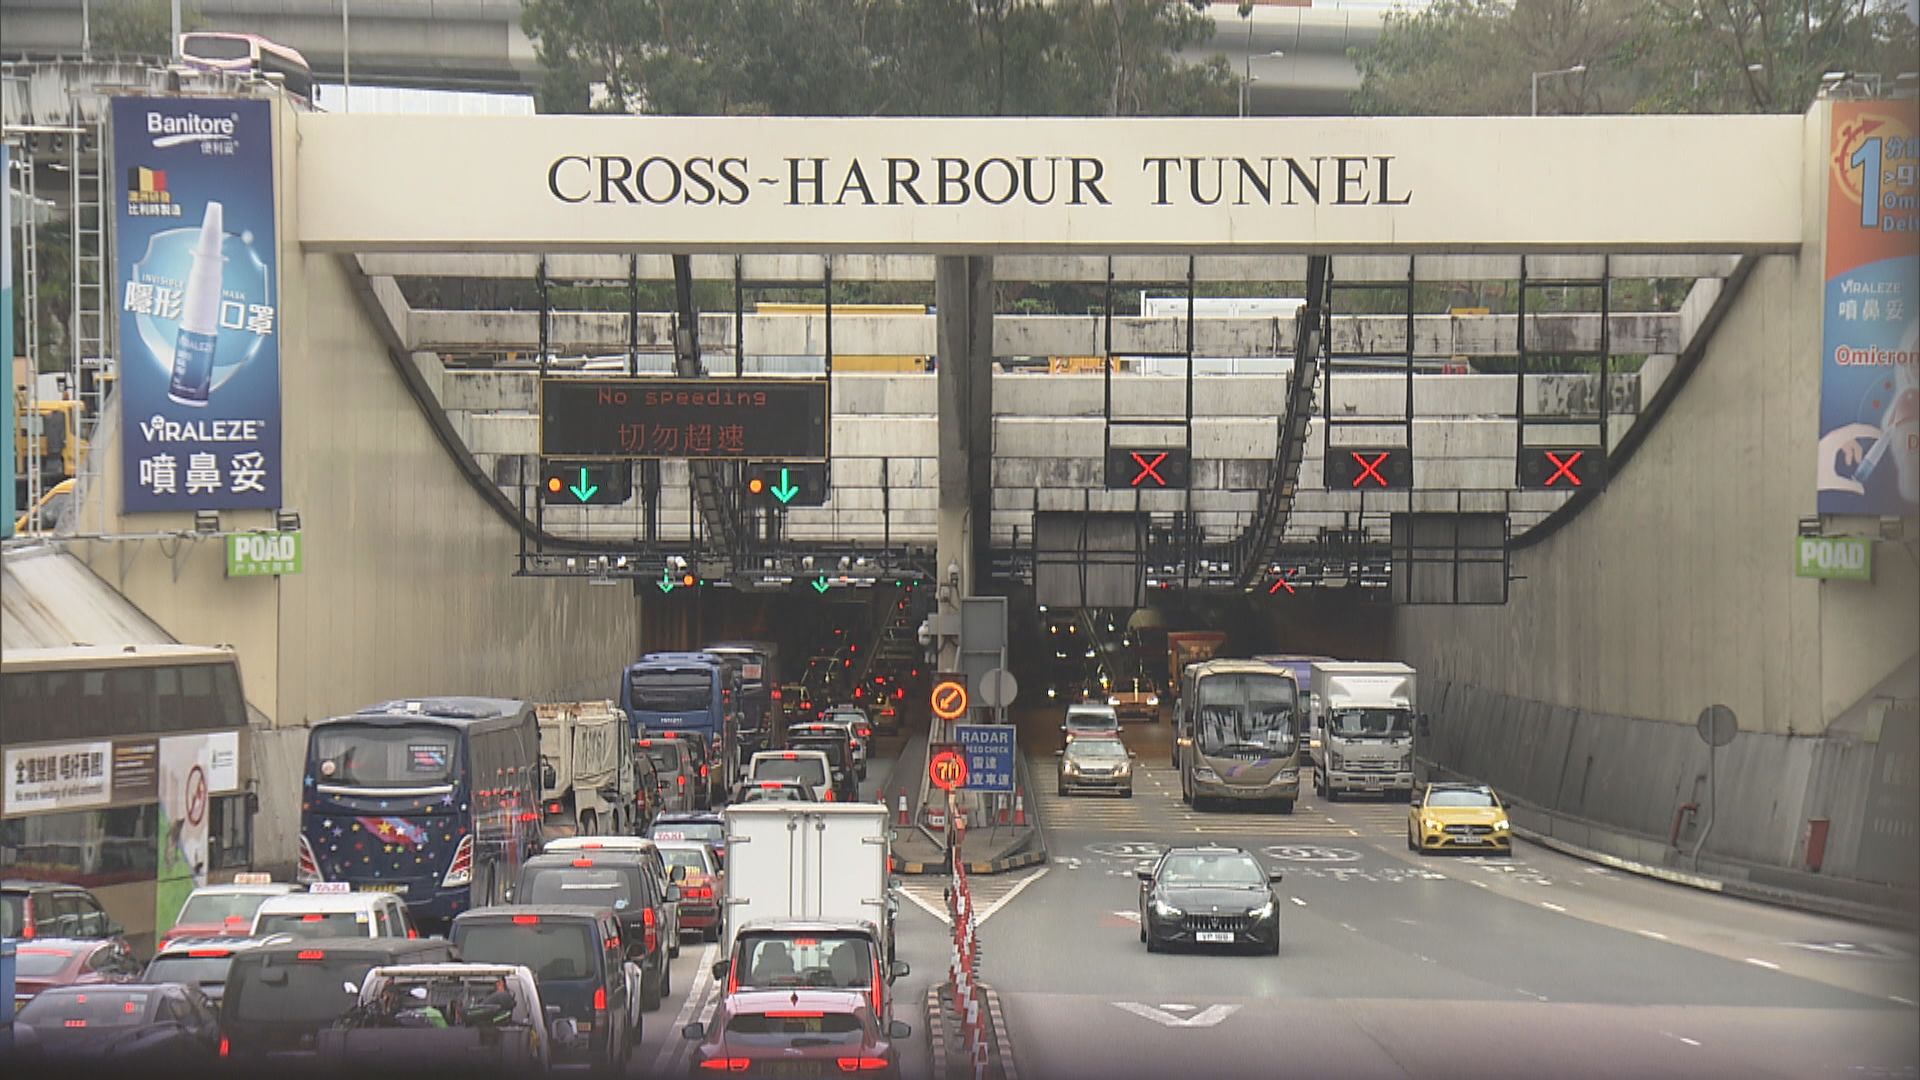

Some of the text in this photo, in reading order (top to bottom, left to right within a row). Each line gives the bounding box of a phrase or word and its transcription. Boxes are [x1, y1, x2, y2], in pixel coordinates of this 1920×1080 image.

[147, 112, 234, 134] Banitore
[1143, 155, 1413, 206] TUNNEL
[1851, 136, 1882, 228] 1
[142, 273, 246, 300] INVISIBLE MASK
[124, 280, 275, 336] 隱形 口罩
[597, 387, 767, 407] No speeding
[618, 423, 745, 452] 切勿超速
[139, 451, 267, 494] 噴鼻妥
[235, 536, 295, 561] POAD
[1801, 541, 1865, 569] POAD
[961, 731, 1009, 744] RADAR
[984, 746, 1009, 754] CHECK
[314, 883, 348, 892] TAXI
